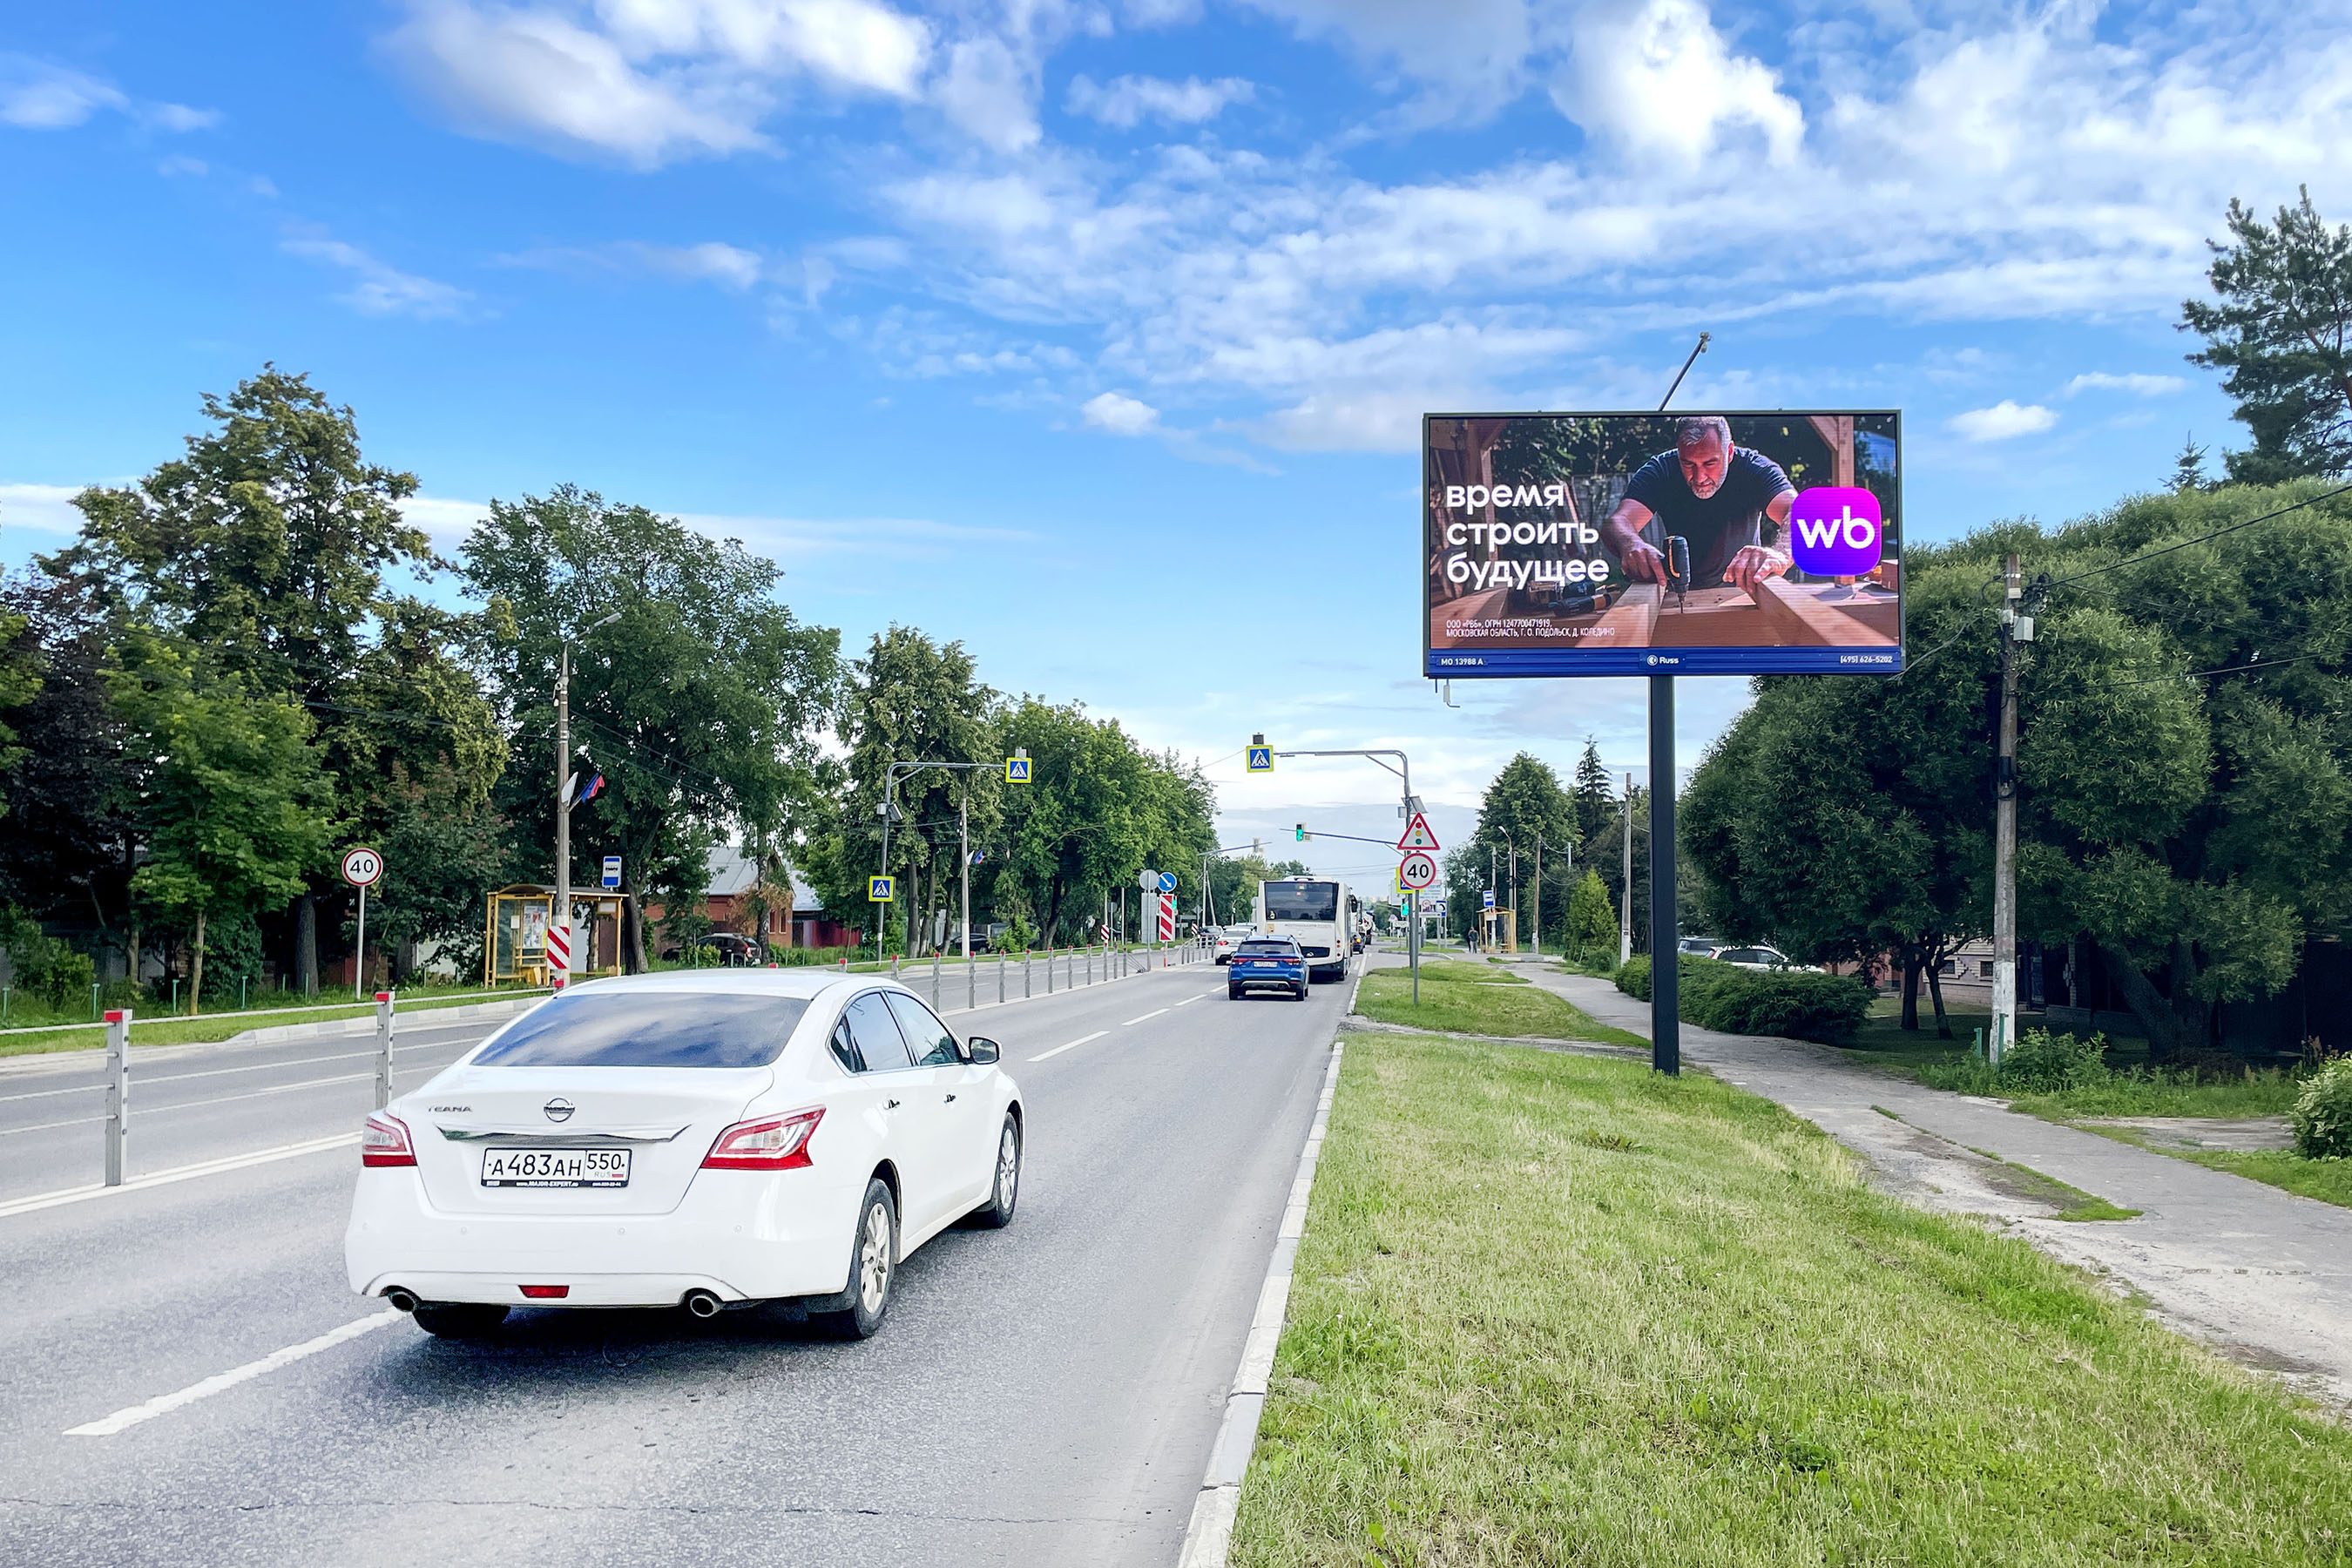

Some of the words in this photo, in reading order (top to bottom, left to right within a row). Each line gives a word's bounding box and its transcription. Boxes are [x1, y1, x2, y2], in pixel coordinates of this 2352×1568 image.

[1446, 484, 1565, 515] время
[1446, 523, 1599, 552] строить
[1796, 505, 1875, 550] wb
[1446, 551, 1610, 591] будущее
[1446, 619, 1461, 628] ООО
[1484, 619, 1501, 628] ОГРН
[1503, 618, 1552, 628] 1247700471919,
[1446, 628, 1489, 637] МОСКОВСКАЯ
[1490, 628, 1519, 638] ОБЛАСТЬ,
[1535, 627, 1571, 637] ПОДОЛЬСК,
[1579, 627, 1615, 637] КОЛЕДИНО
[349, 859, 374, 874] 40
[1407, 863, 1429, 878] 40
[491, 1154, 582, 1176] А483АН
[586, 1153, 621, 1170] 550
